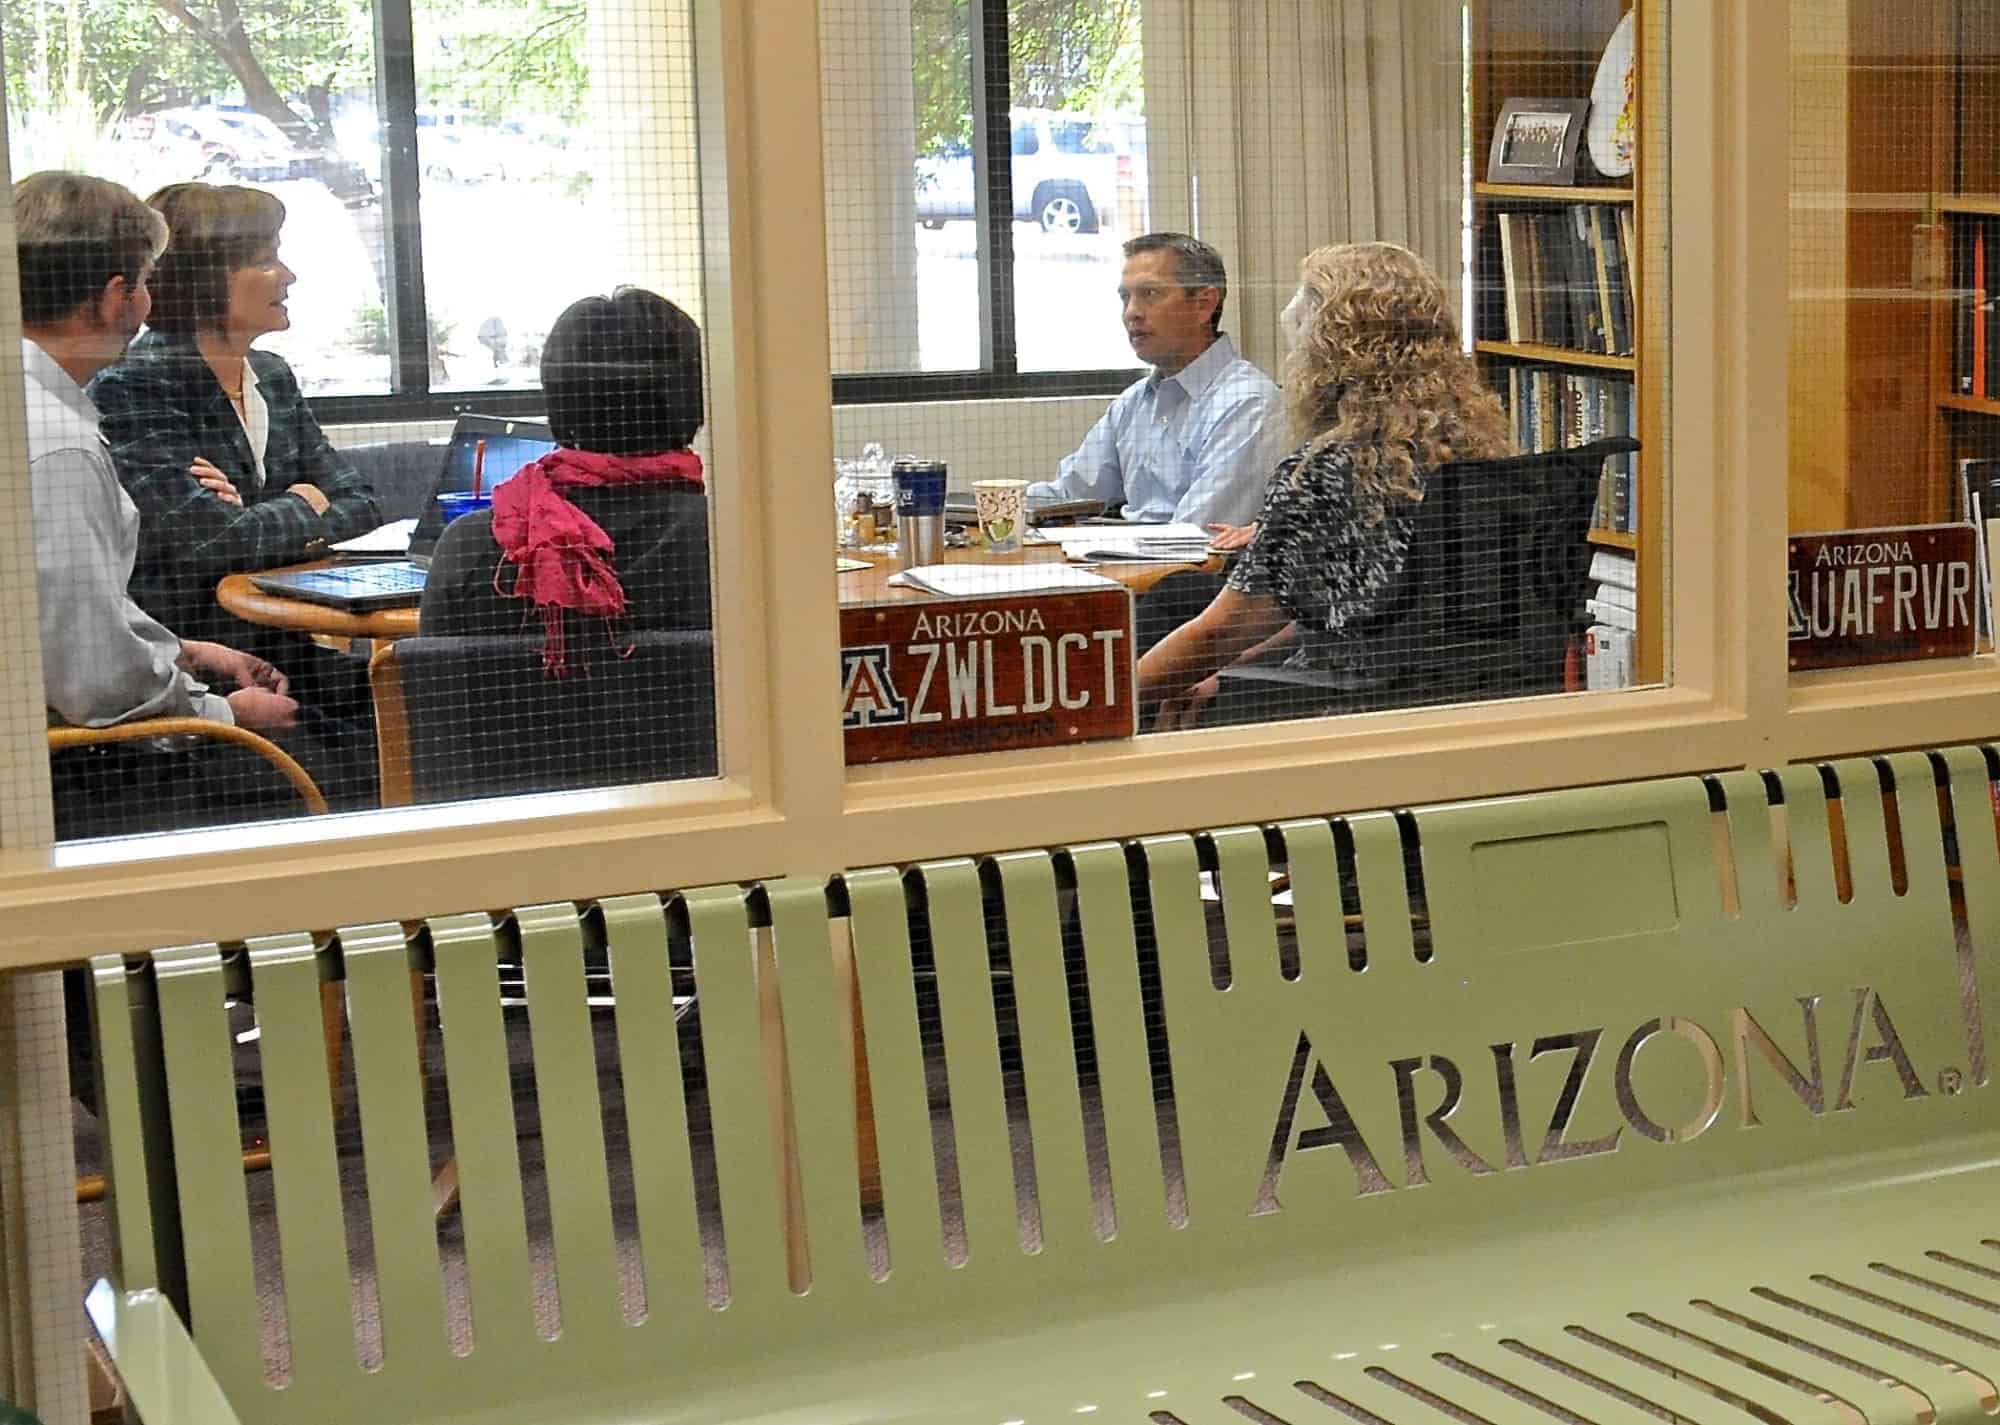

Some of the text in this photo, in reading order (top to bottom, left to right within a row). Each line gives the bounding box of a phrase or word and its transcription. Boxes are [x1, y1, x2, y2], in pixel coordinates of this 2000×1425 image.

[1815, 541, 1914, 567] ARIZONA
[912, 608, 1046, 640] ARIZONA
[1811, 561, 1970, 638] UAFRVR
[907, 629, 1124, 724] ZWLDCT
